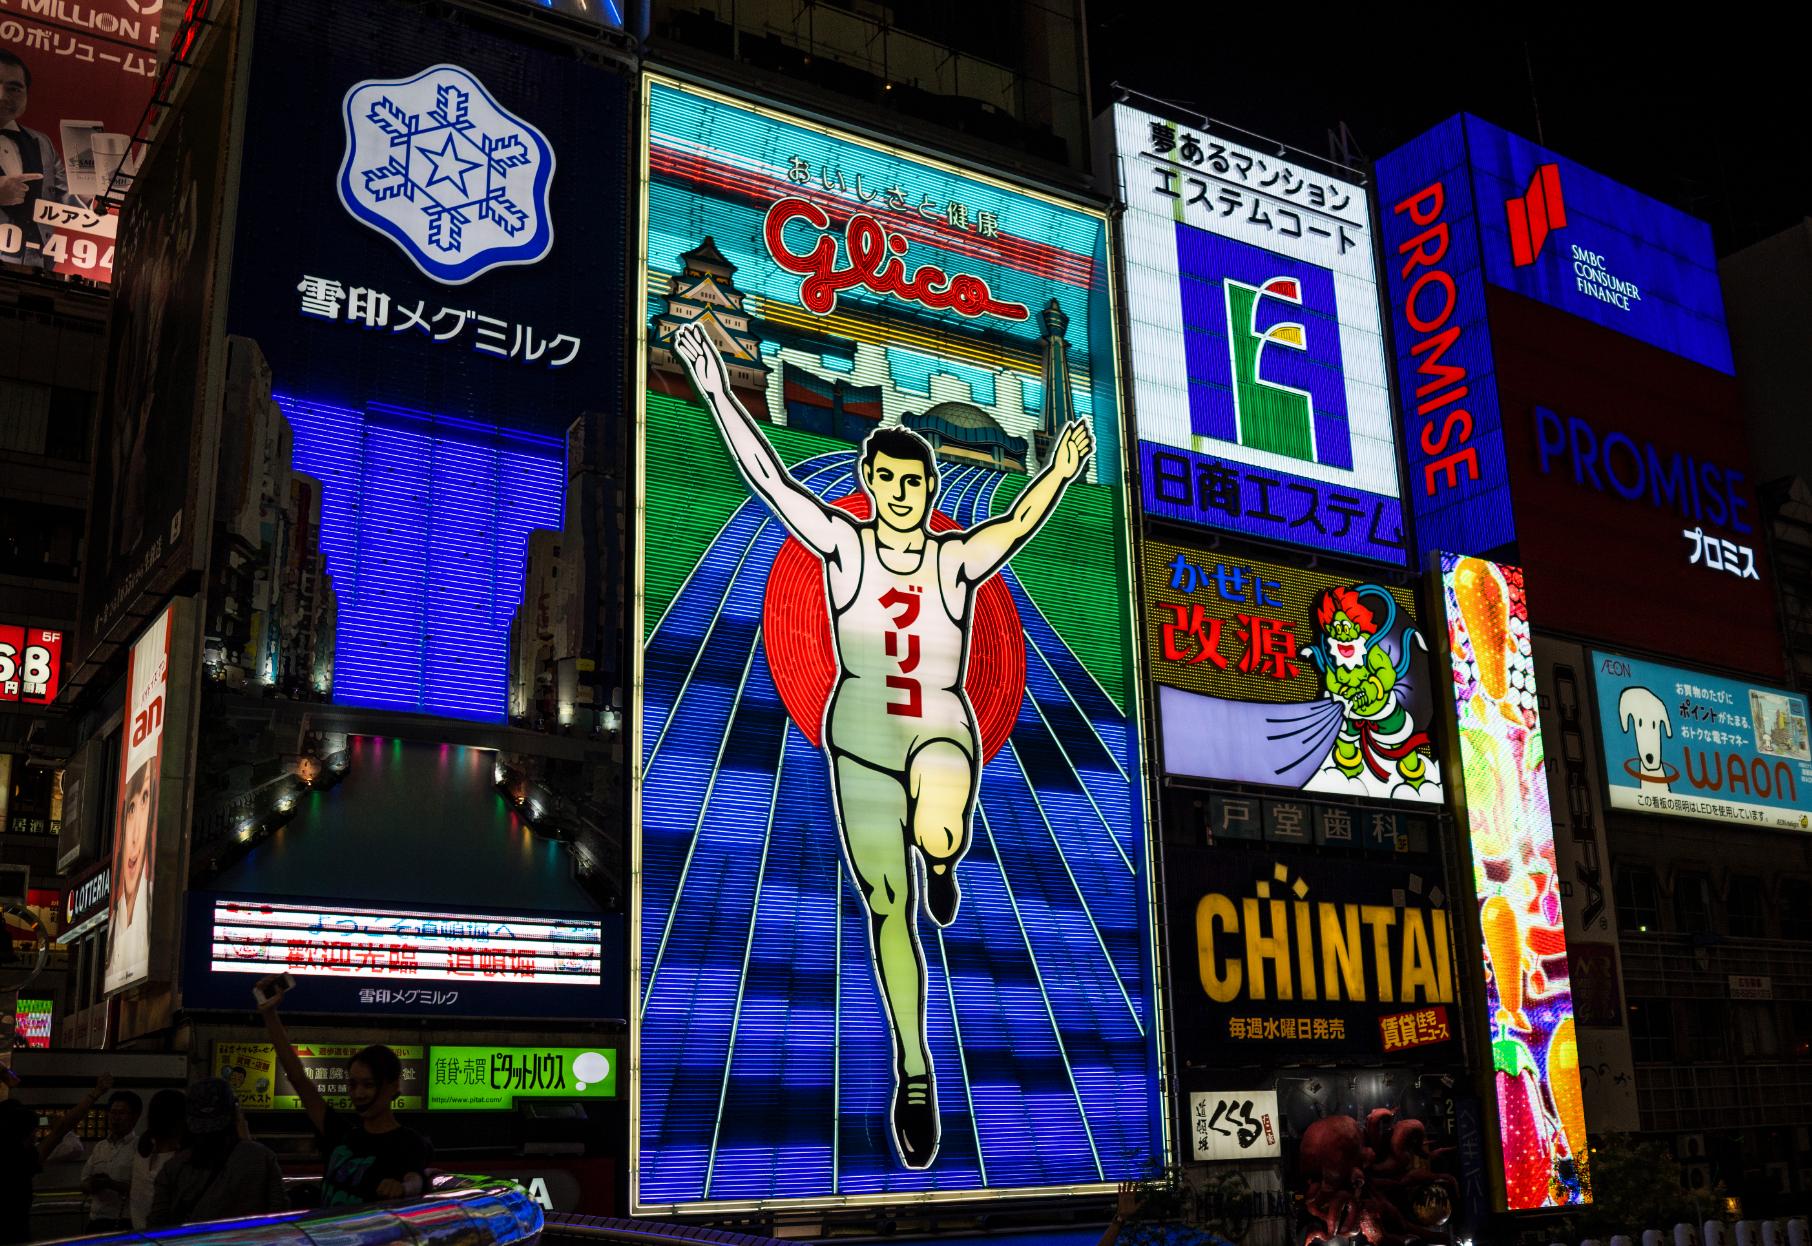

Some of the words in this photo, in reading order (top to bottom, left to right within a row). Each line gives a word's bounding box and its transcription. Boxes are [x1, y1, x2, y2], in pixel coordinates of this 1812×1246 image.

[21, 0, 140, 40] MILLION
[1150, 121, 1351, 212] 夢あるマンション
[787, 156, 998, 239] おいしさと健康
[1153, 166, 1357, 255] エステムコート
[763, 196, 1030, 316] Glico
[1571, 244, 1606, 271] SMBC
[1574, 261, 1642, 301] CONSUMER
[297, 275, 581, 366] 雪印メグミルク
[1576, 276, 1631, 312] FINANCE
[1394, 181, 1480, 496] PROMISE
[1535, 404, 1754, 534] PROMISE
[1153, 451, 1405, 549] 日商エステム
[1168, 553, 1284, 608] かぜに
[1683, 527, 1760, 581] プロミス
[42, 631, 61, 643] 5F
[878, 584, 923, 718] グリコ
[1158, 601, 1301, 680] 改源
[133, 695, 163, 748] an
[1683, 746, 1797, 802] WAON
[74, 867, 110, 915] LOTTERIA
[359, 987, 459, 1007] 雪印メグミルク
[1229, 1017, 1346, 1040] 毎週水曜日発売
[490, 1053, 566, 1091] ピタットハウス
[1208, 1100, 1263, 1149] くくる
